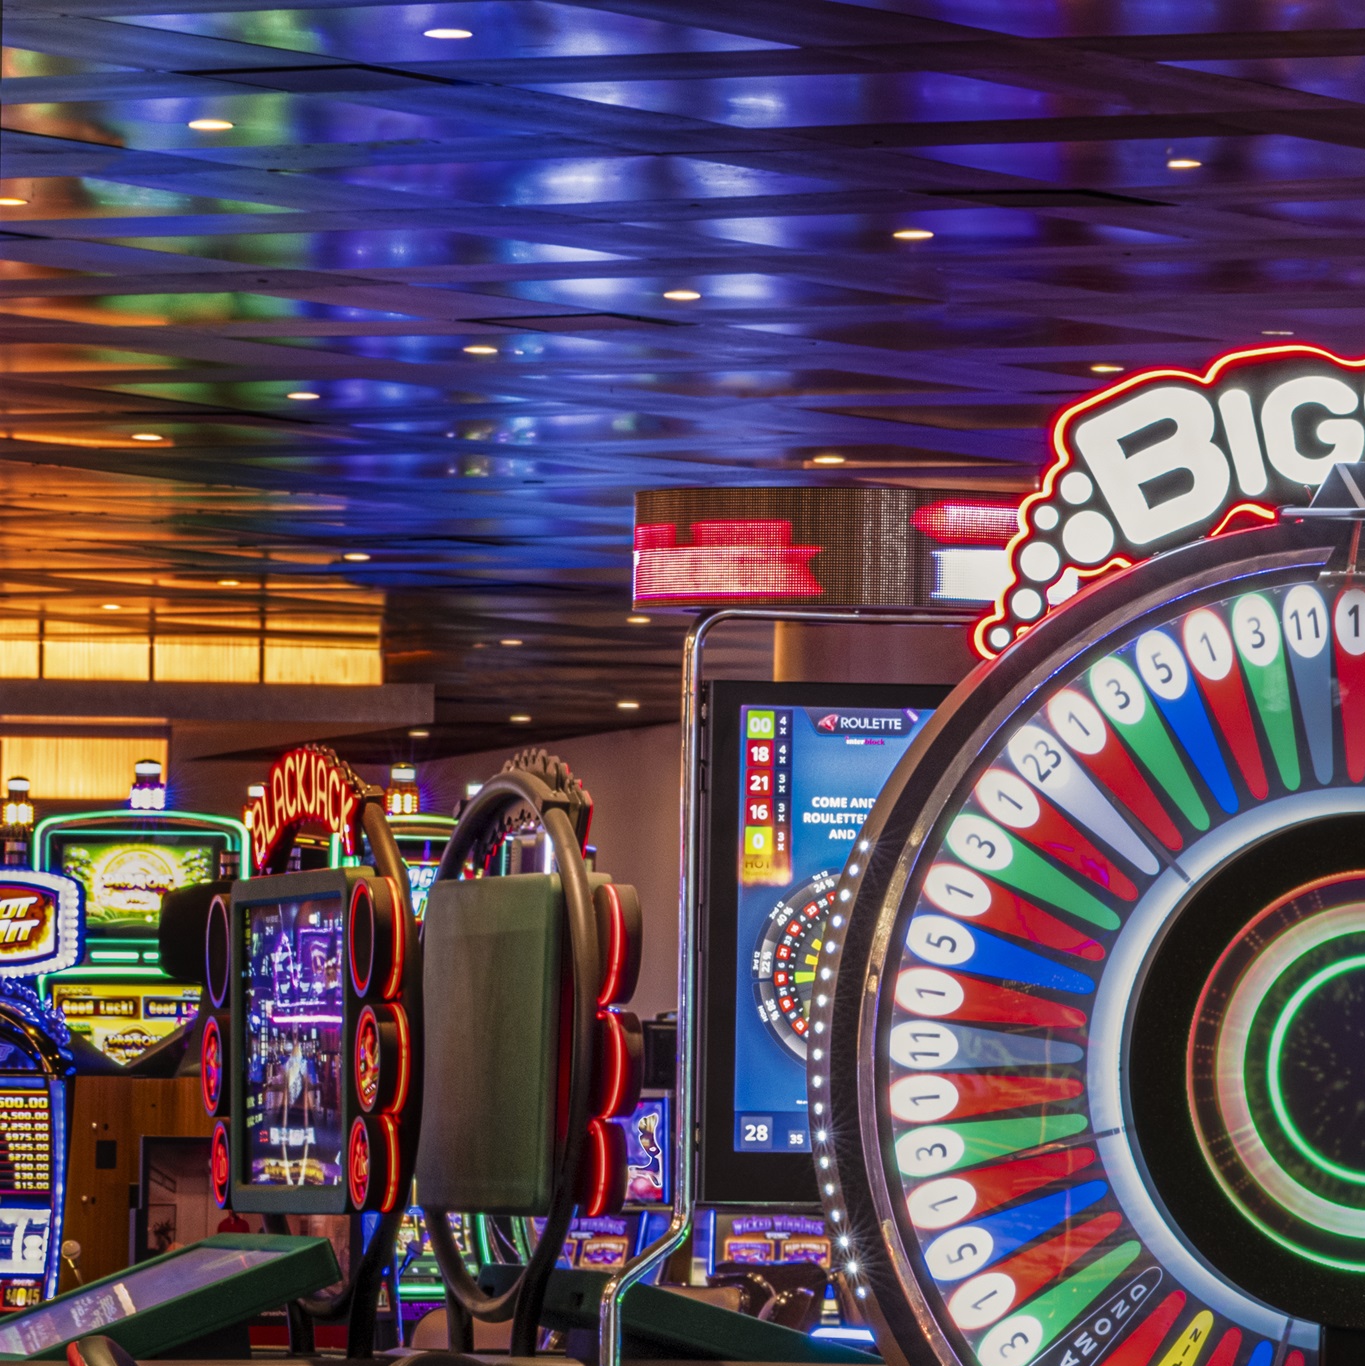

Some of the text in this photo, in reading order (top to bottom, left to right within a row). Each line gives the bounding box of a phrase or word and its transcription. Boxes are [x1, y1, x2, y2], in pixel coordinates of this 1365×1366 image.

[1289, 607, 1321, 641] 11
[1347, 604, 1361, 638] 1
[1247, 616, 1266, 649] 3
[1199, 632, 1217, 662] 1
[1150, 652, 1173, 684] 5
[1106, 679, 1131, 710] 3
[750, 719, 771, 733] 00
[840, 717, 902, 730] ROULETTE
[1068, 711, 1091, 736] 1
[845, 736, 885, 745] interblock
[751, 747, 769, 762] 18
[1022, 740, 1062, 783] 23
[750, 775, 769, 791] 21
[812, 797, 847, 808] COME
[997, 789, 1023, 811] 1
[252, 752, 353, 865] BLACKJACK
[750, 805, 768, 820] 16
[753, 833, 764, 848] 0
[829, 829, 856, 840] AND
[965, 833, 996, 859] 3
[944, 883, 975, 899] 1
[777, 914, 788, 927] 40
[925, 932, 957, 953] 5
[762, 960, 771, 973] 22
[915, 987, 946, 999] 1
[62, 1000, 134, 1015] Good Luck!
[149, 1002, 177, 1014] Good
[910, 1030, 941, 1060] 11
[910, 1093, 941, 1106] 1
[5, 1133, 49, 1141] $975.00
[744, 1124, 769, 1141] 28
[790, 1134, 803, 1144] 35
[8, 1143, 49, 1151] $525.00
[916, 1142, 948, 1161] 3
[8, 1153, 49, 1161] $270.00
[14, 1163, 49, 1171] $90.00
[14, 1172, 49, 1180] $30.00
[14, 1181, 49, 1190] $15.00
[928, 1195, 959, 1212] 1
[945, 1242, 979, 1266] 5
[971, 1289, 999, 1312] 1
[999, 1331, 1031, 1359] 3
